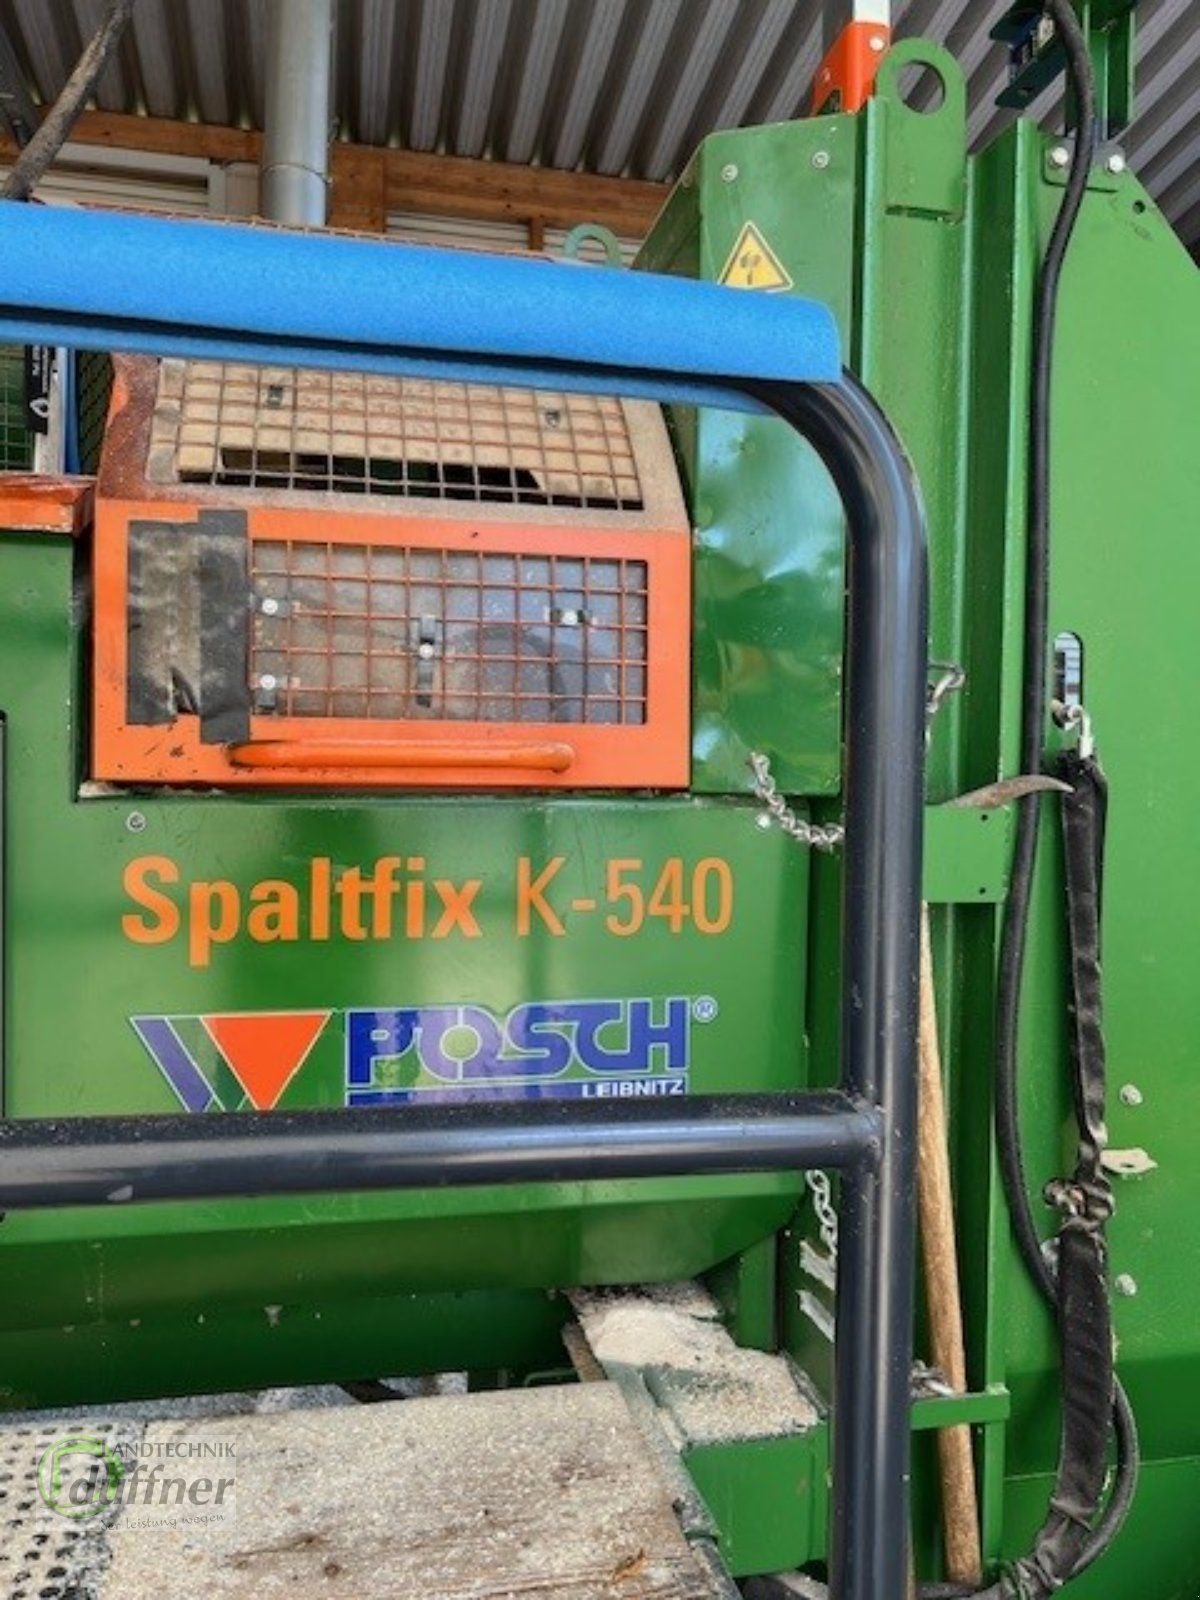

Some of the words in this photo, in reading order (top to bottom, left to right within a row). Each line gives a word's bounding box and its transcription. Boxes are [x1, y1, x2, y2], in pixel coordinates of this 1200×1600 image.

[121, 856, 482, 967] Spaltfix
[515, 857, 733, 937] K-540
[346, 998, 690, 1089] POSCH
[582, 1080, 683, 1098] LEIBNITZ
